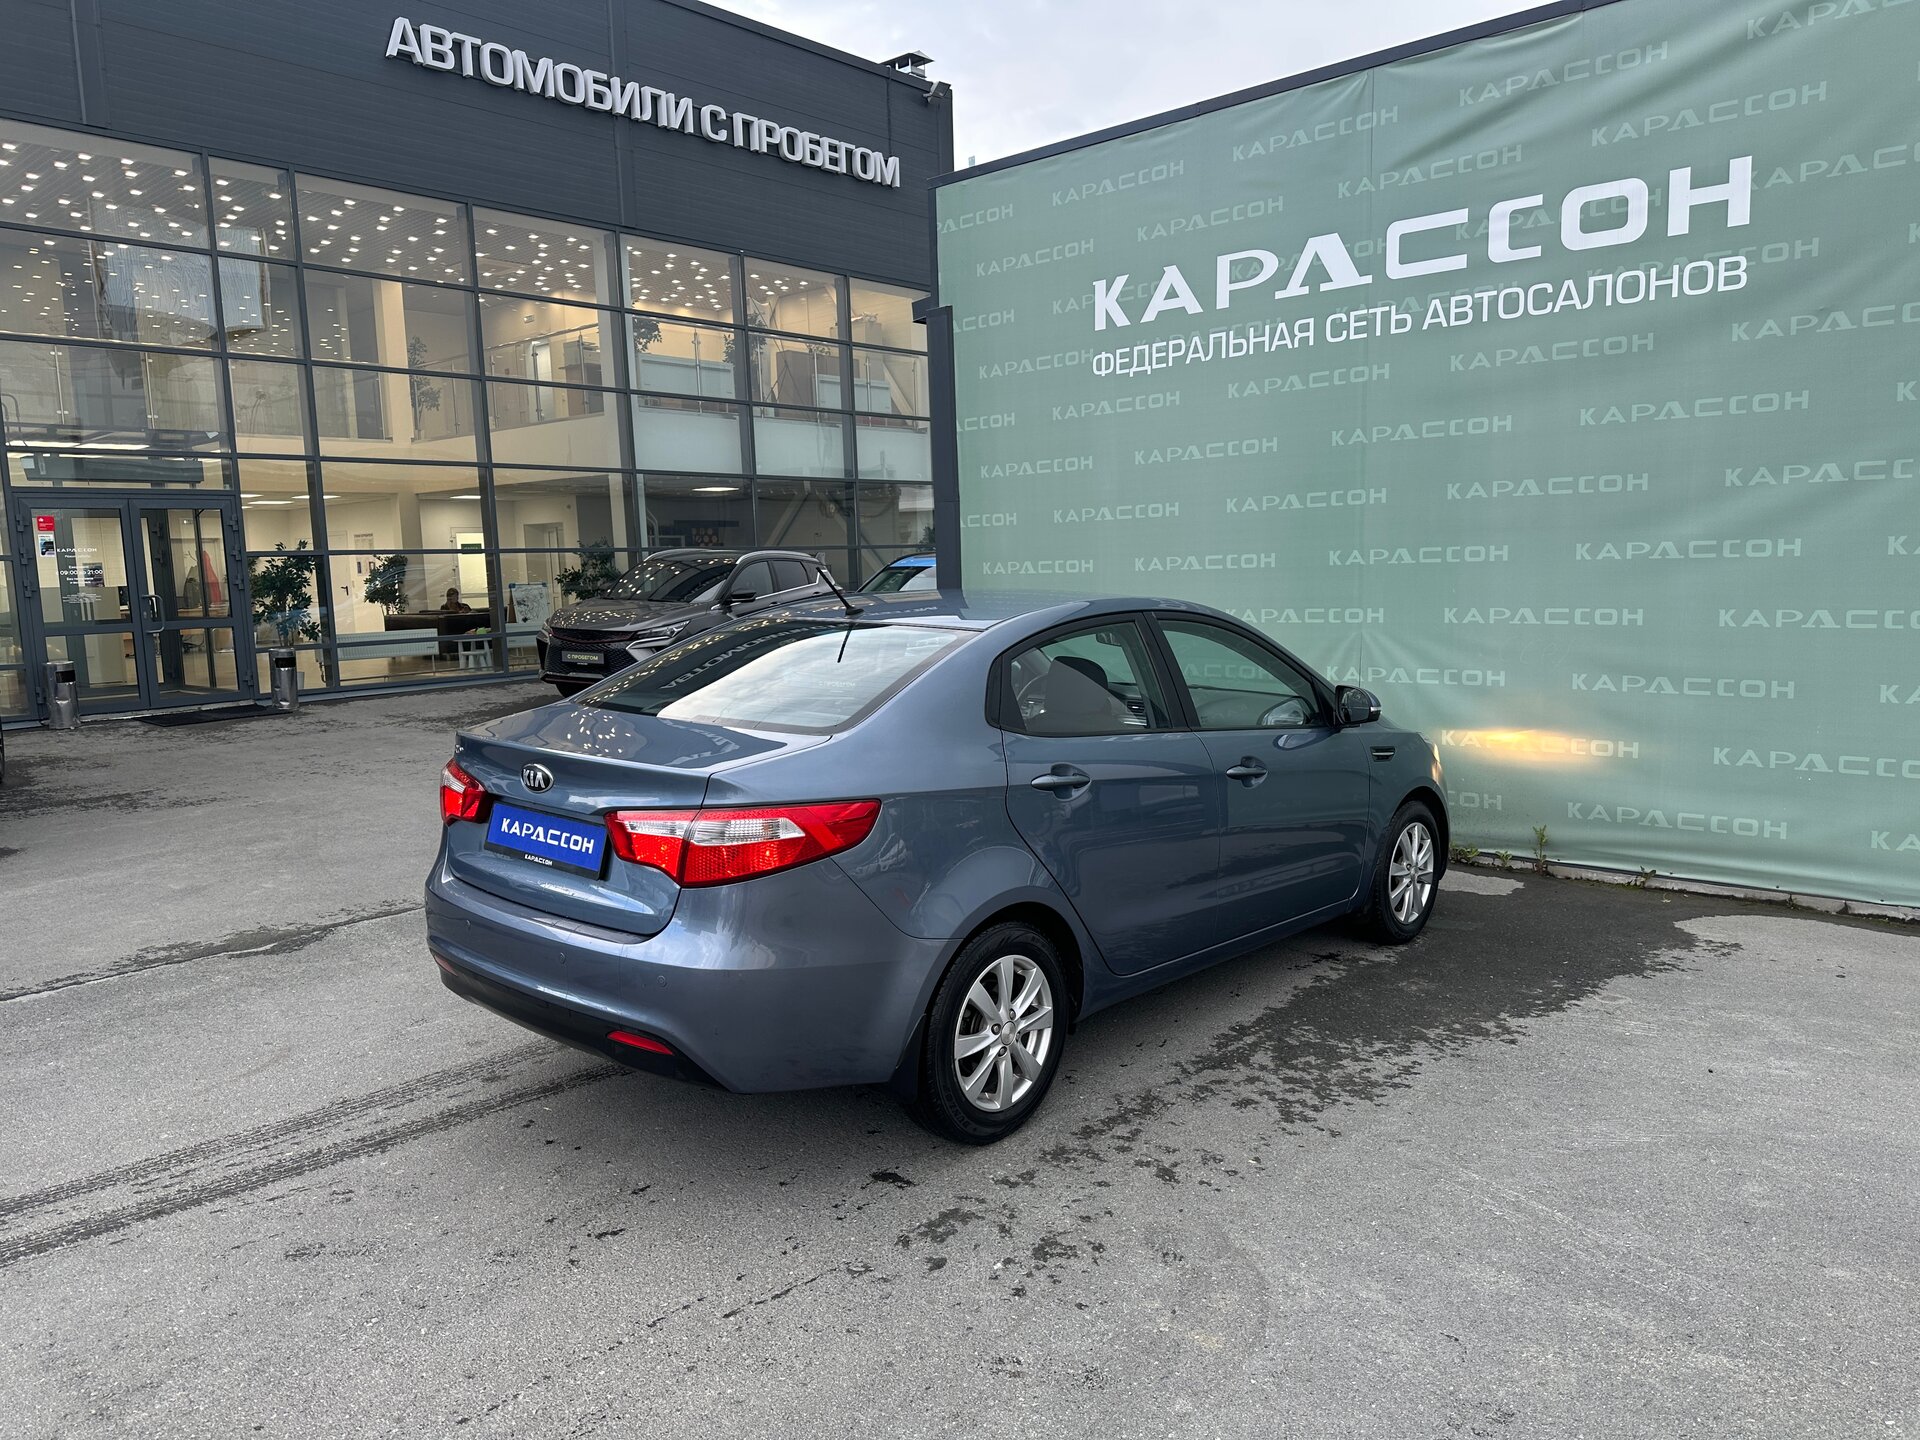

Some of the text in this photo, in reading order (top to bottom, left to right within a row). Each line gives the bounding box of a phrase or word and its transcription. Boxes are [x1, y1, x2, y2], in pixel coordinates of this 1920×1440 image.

[1747, 0, 1915, 40] КАРА
[1459, 41, 1668, 106] КАРАССОН
[385, 16, 900, 188] АВТОМОБИЛИ С ПРОБЕГОМ
[1591, 80, 1827, 147] КАРАССОН
[1232, 105, 1398, 162] КАРАССОН
[1052, 159, 1184, 206] КАРАССОН
[1338, 144, 1522, 198] КАРАССОН
[1137, 195, 1284, 243] КАРАССОН
[976, 238, 1094, 277] КАРАССОН
[1093, 155, 1752, 331] КАРАССОН
[1092, 255, 1748, 377] ФЕДЕРАЛЬНАЯ СЕТЬ АВТОСАЛОНОВ
[979, 349, 1093, 379] КАРАССОН
[1450, 332, 1654, 372] КАРАССОН
[1227, 363, 1390, 399] КАРАССОН
[1052, 391, 1180, 422] КАРАССОН
[1579, 390, 1809, 426] КАРАССОН
[1331, 414, 1512, 446] КАРАССОН
[1134, 437, 1278, 465] КАРАССОН
[981, 456, 1093, 479] КАРАССОН
[1724, 458, 1920, 487] КАРАСС
[1226, 488, 1387, 514] КАРАССОН
[1447, 472, 1649, 500] КАРАССОН
[1054, 502, 1179, 523] КАРАССОН
[1134, 553, 1276, 572] КАРАССОН
[1328, 545, 1509, 566] КАРАССОН
[1575, 538, 1801, 560] КАРАССОН
[983, 559, 1093, 575] КАРАССОН
[1444, 608, 1643, 626] КАРАССОН
[1326, 666, 1505, 687] КАРАССОН
[1572, 673, 1795, 699] КАРАССОН
[523, 769, 545, 788] KIA
[501, 818, 594, 854] КАРАССОН
[1567, 801, 1787, 840] КАРАССОН
[524, 854, 553, 866] КАРАССОН
